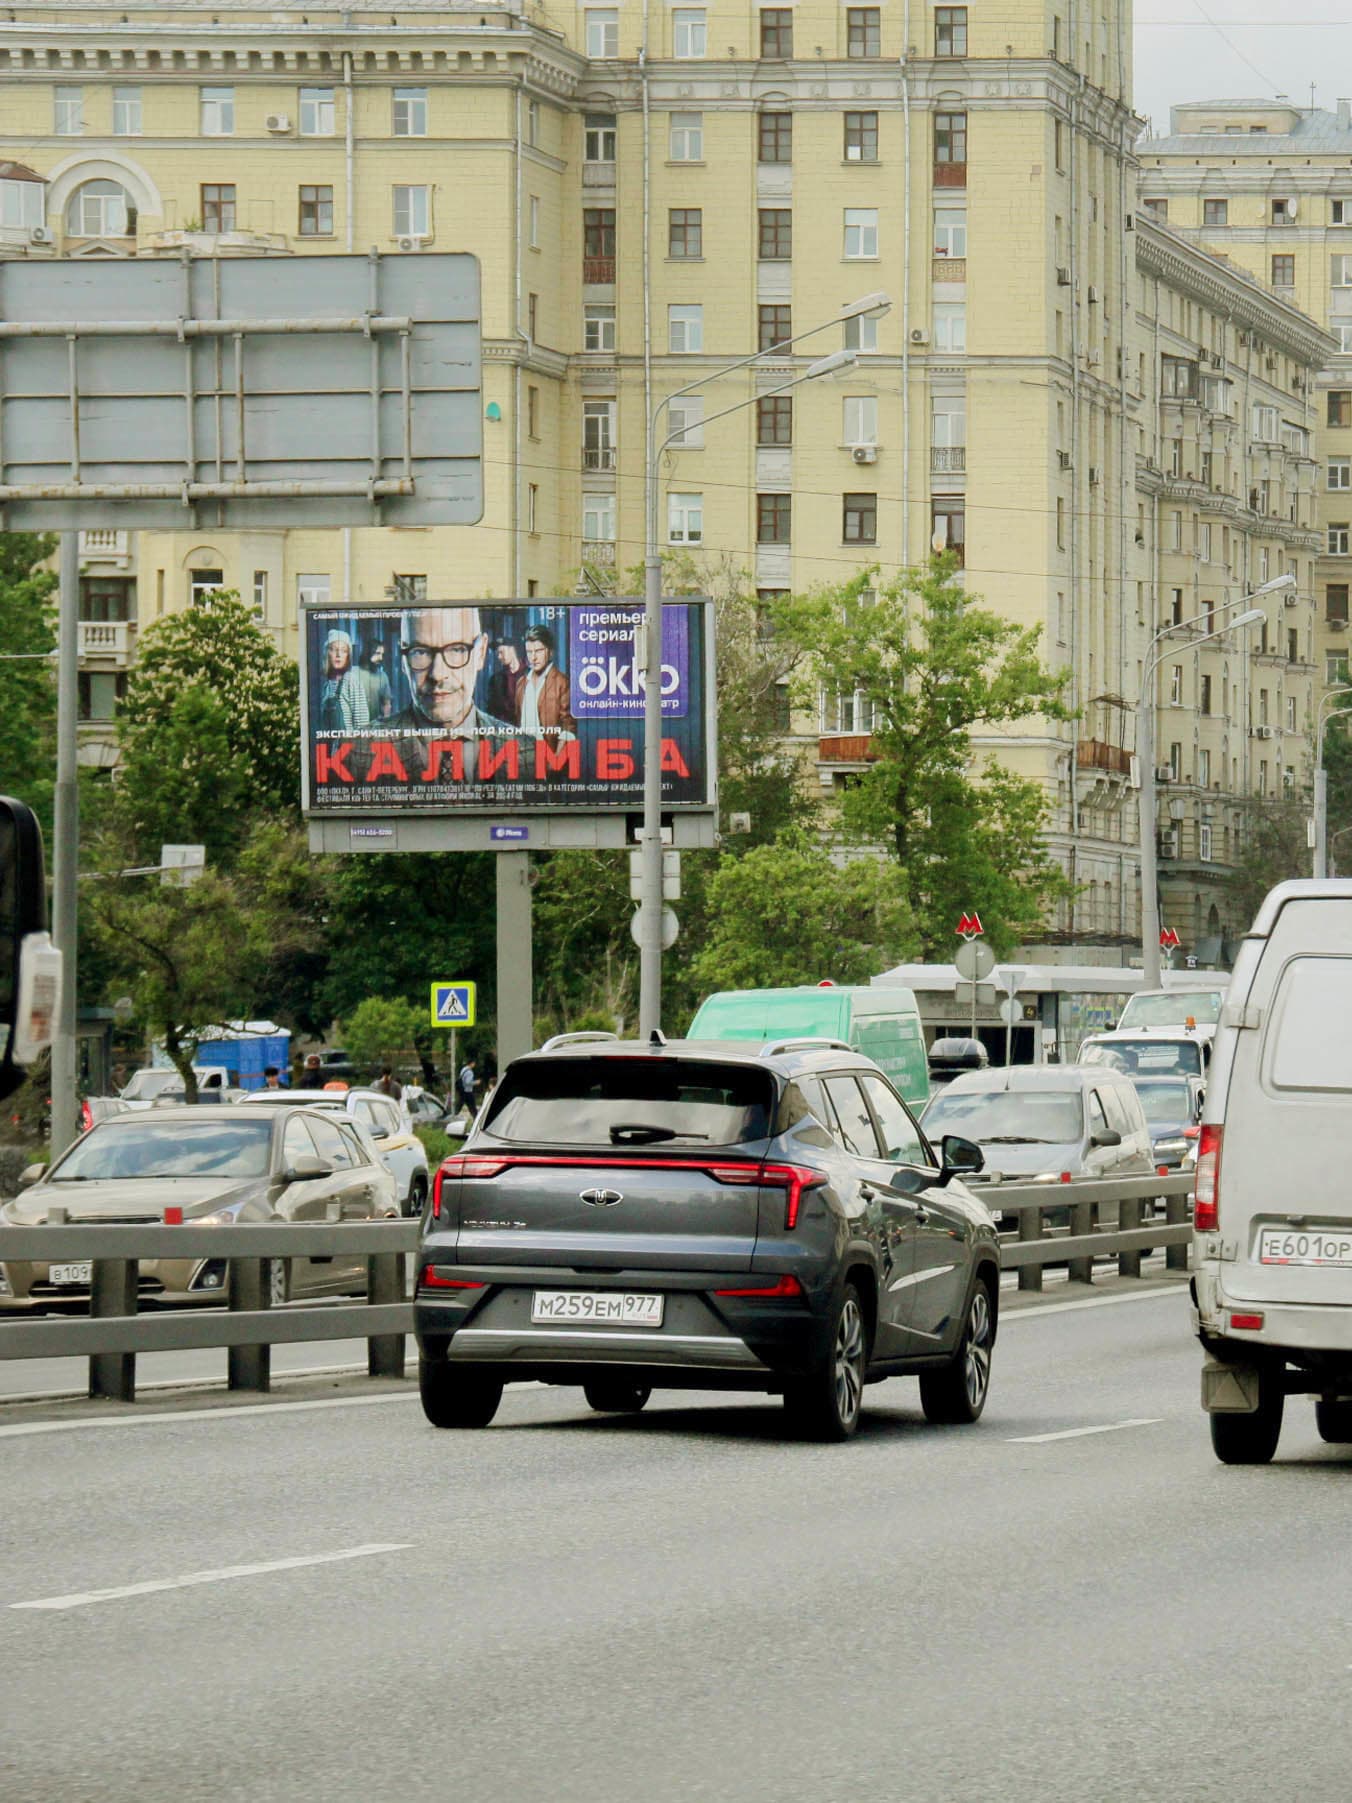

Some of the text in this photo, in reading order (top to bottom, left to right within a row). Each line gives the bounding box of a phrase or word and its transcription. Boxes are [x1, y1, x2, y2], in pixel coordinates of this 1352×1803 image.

[539, 607, 566, 621] 18+
[578, 612, 647, 627] премьер
[578, 629, 635, 644] сериал
[315, 728, 401, 739] ЭКСПЕРИМЕНТ
[403, 727, 448, 738] ВЫШЕЛ
[315, 738, 691, 783] КАЛИМБА
[1269, 1235, 1351, 1258] Е601ОР
[540, 1295, 657, 1317] М259ЕМ 977
